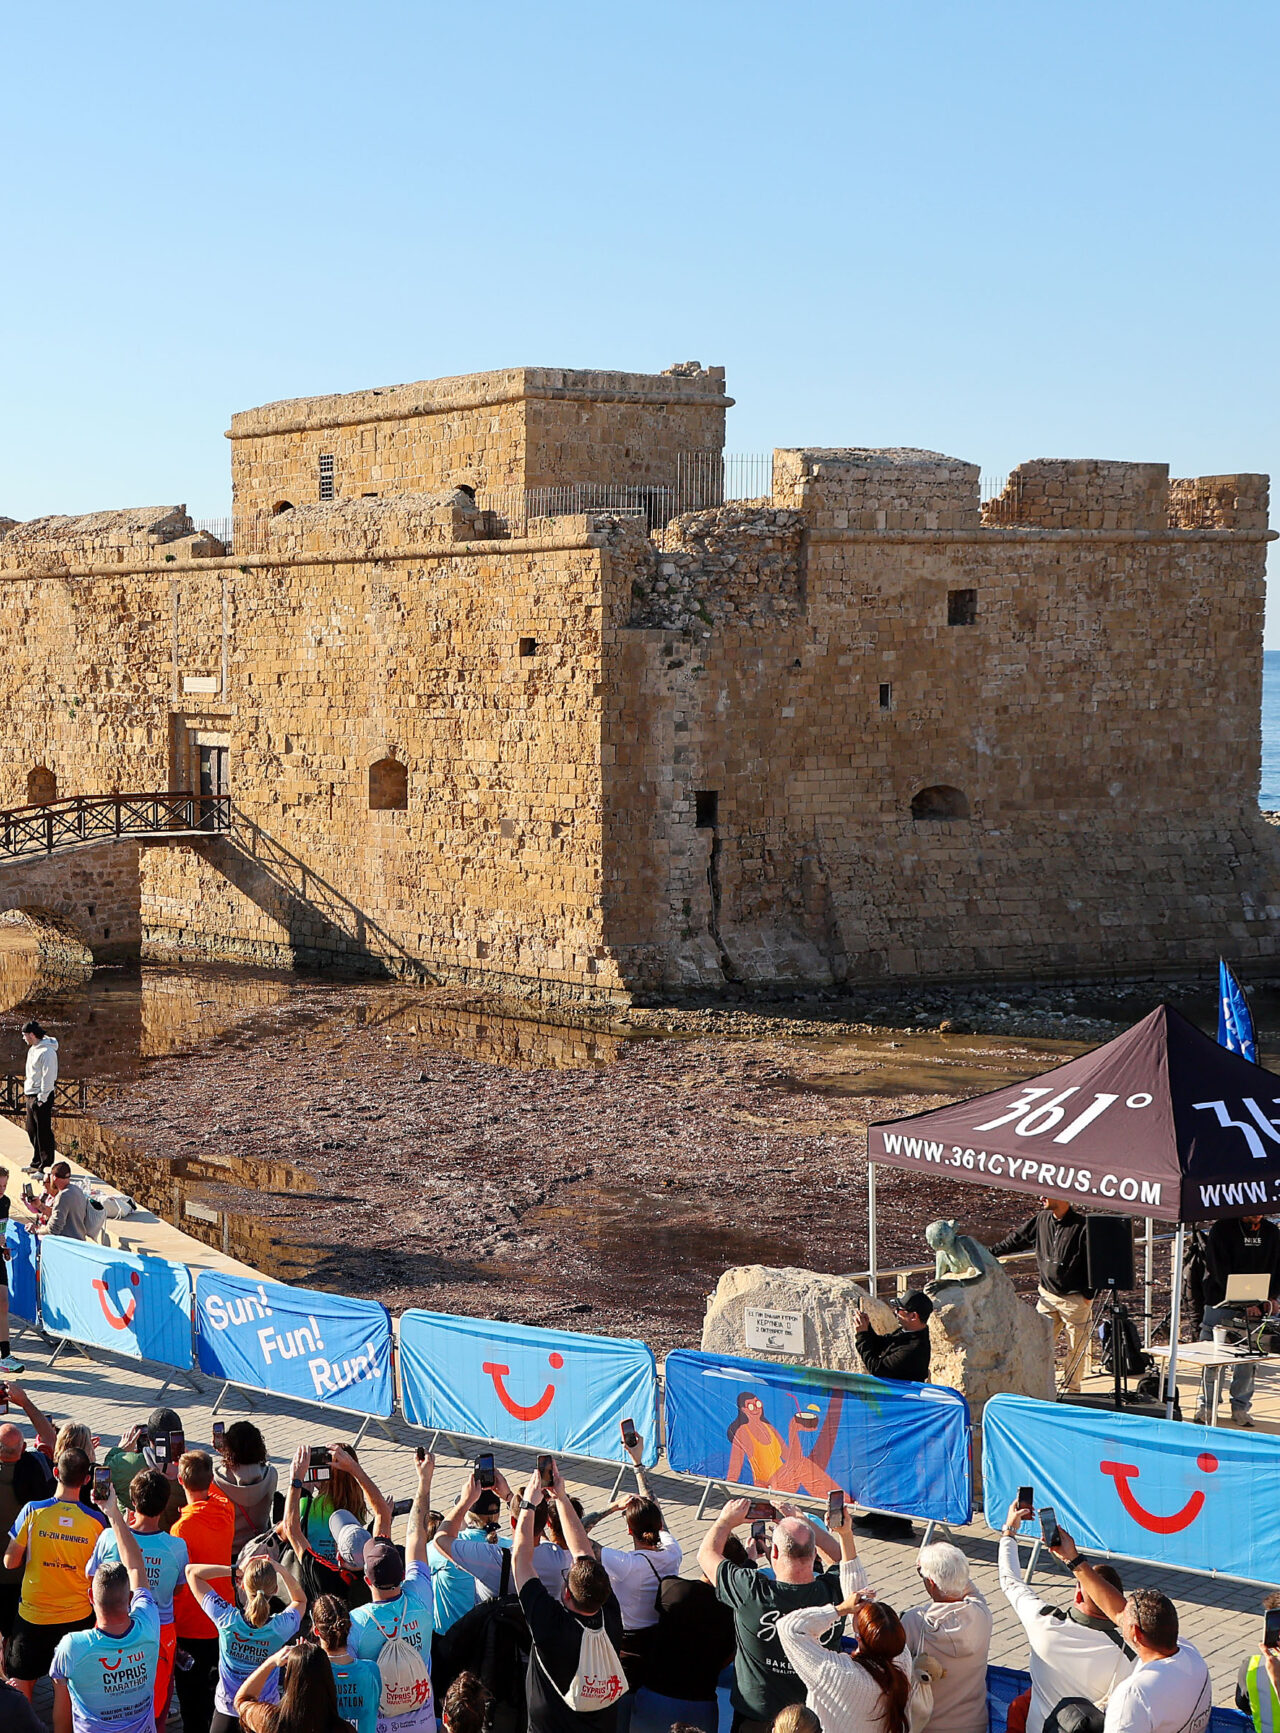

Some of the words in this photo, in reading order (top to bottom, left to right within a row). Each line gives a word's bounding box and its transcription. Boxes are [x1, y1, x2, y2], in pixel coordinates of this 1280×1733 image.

[882, 1132, 1161, 1206] WWW.361CYPRUS.COM
[204, 1284, 274, 1331] Sun!
[256, 1315, 326, 1365] Fun!
[307, 1342, 382, 1396] Run!
[60, 1533, 89, 1545] RUNNERS
[145, 1556, 162, 1565] TUI
[403, 1619, 419, 1632] TUI
[231, 1641, 269, 1658] CYPRUS
[127, 1651, 145, 1664] TUI
[765, 1657, 793, 1670] BAKE
[102, 1662, 147, 1685] CYPRUS
[103, 1674, 148, 1694] MARATHON
[336, 1683, 358, 1695] USZE
[582, 1684, 606, 1695] CYPRUS
[338, 1695, 364, 1708] ATLON
[386, 1692, 412, 1701] CYPRUS
